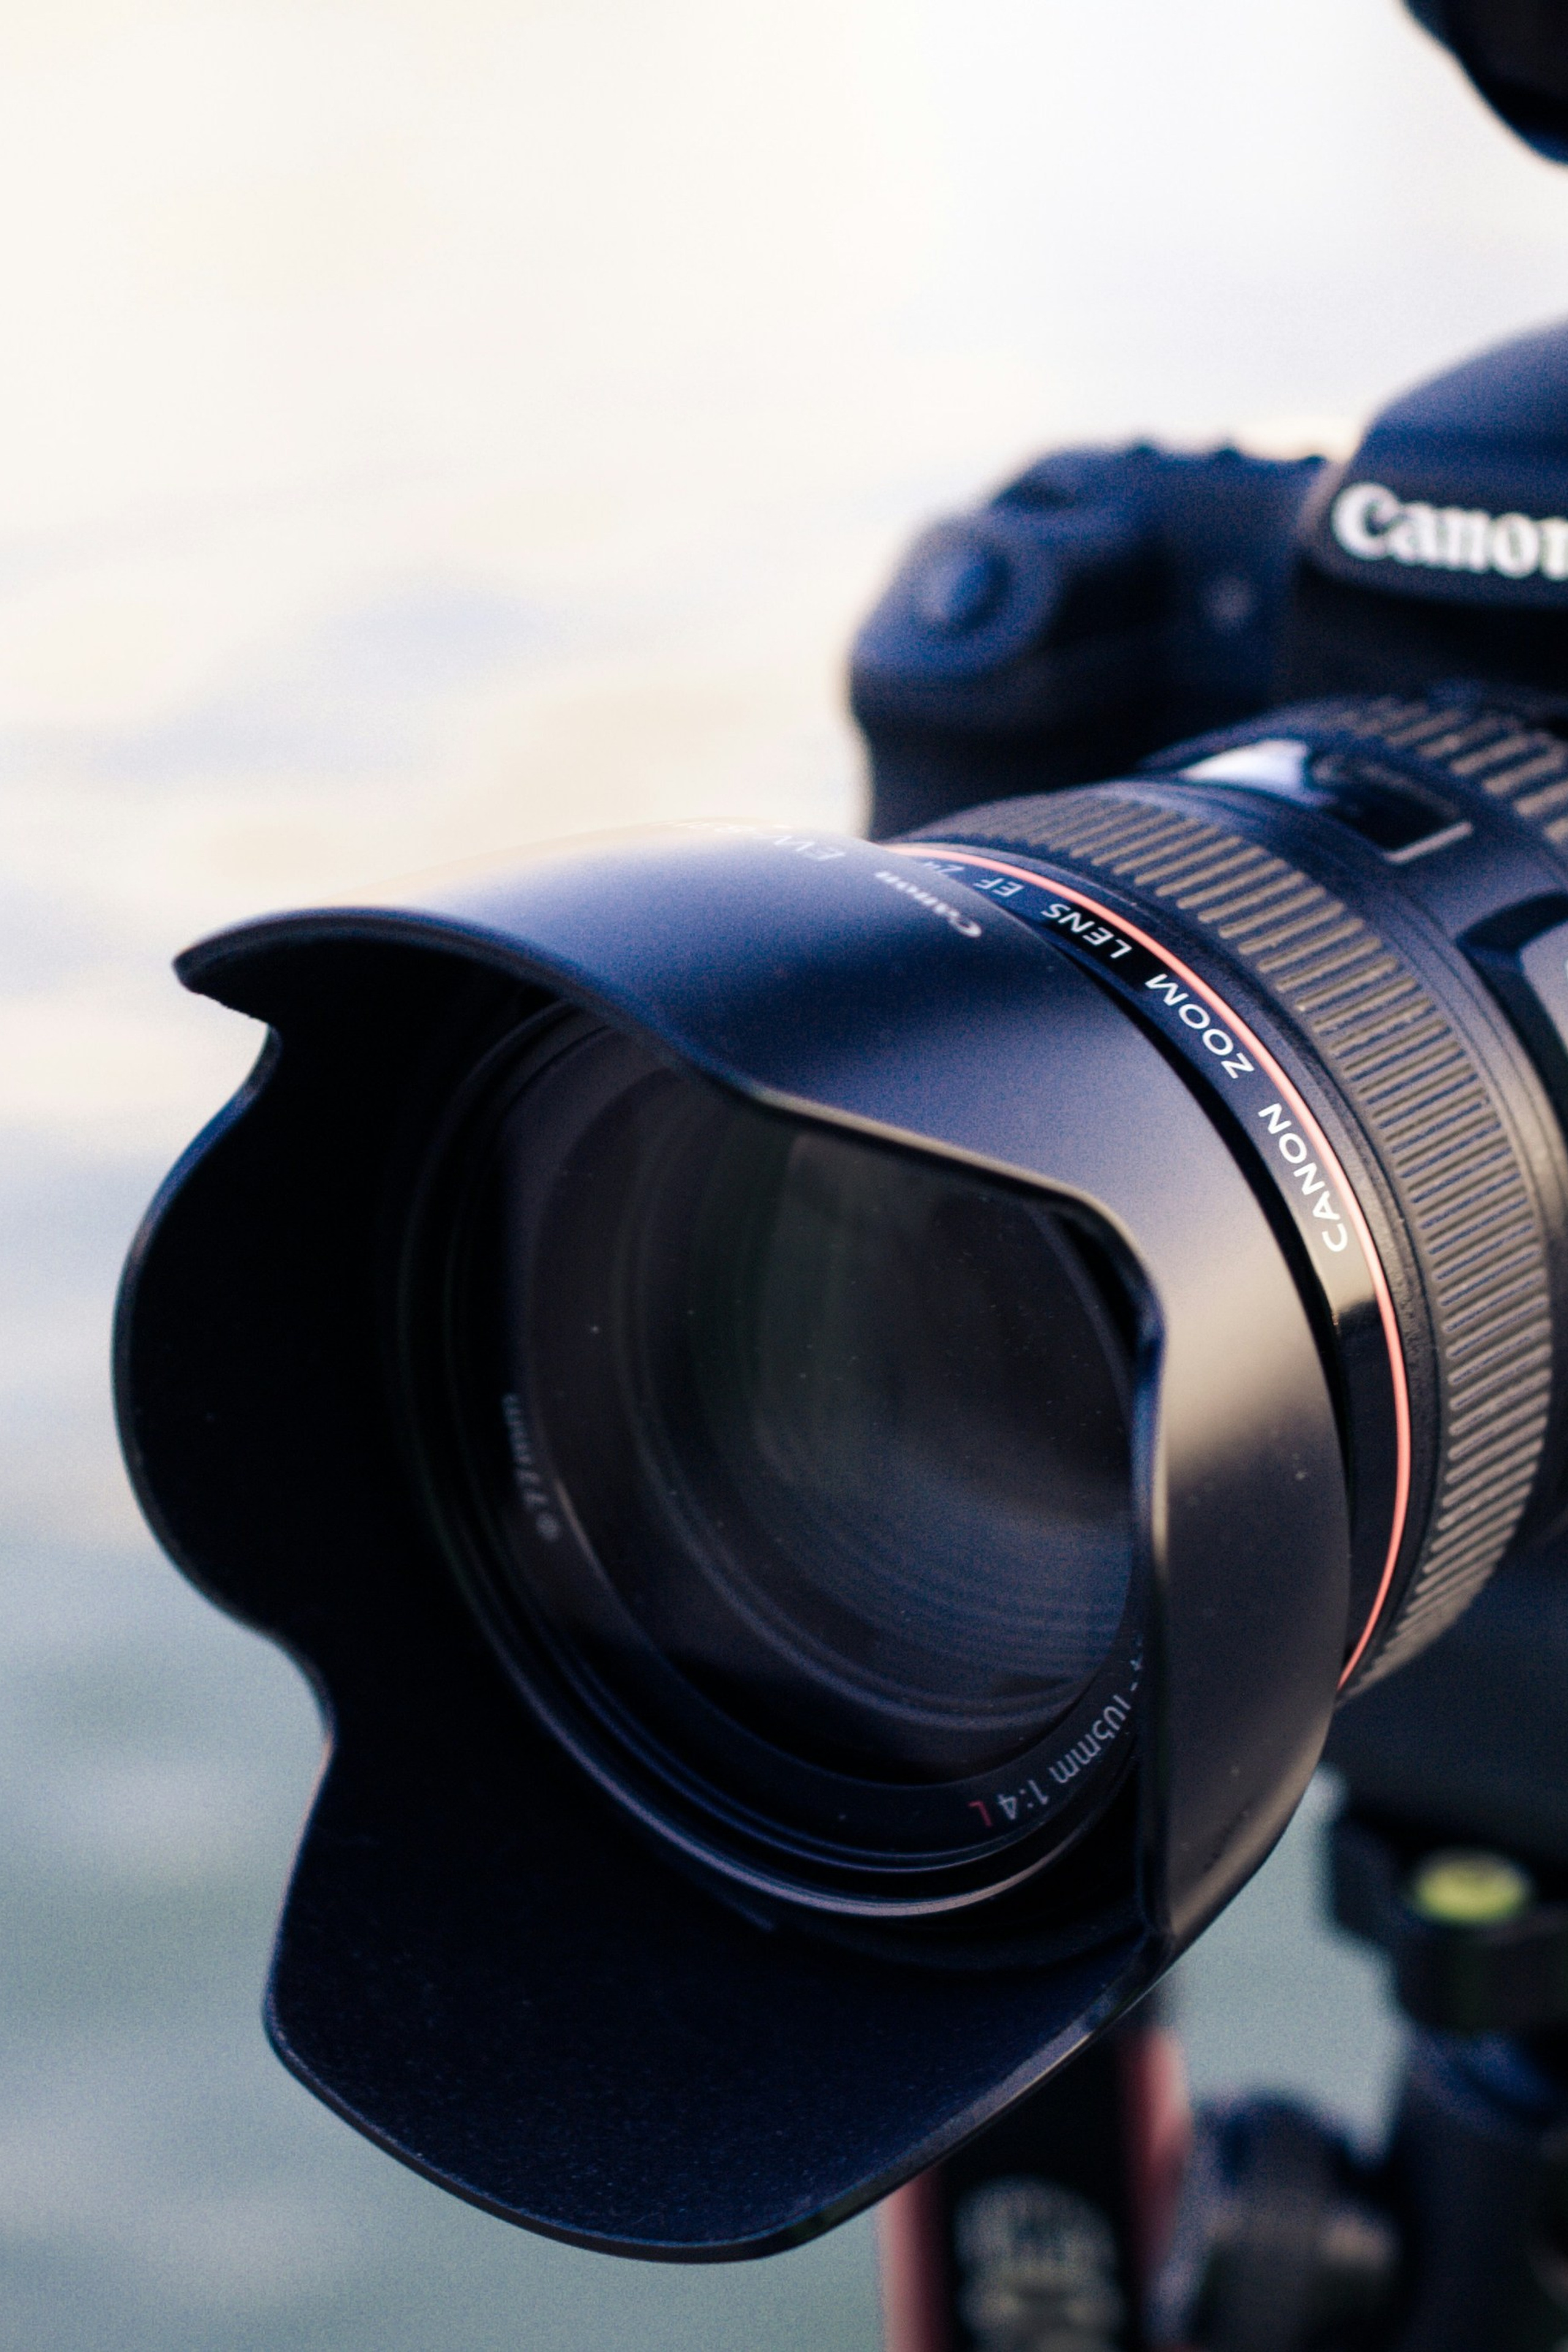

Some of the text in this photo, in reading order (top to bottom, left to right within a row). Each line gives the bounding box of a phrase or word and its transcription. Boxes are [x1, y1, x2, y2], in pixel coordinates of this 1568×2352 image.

[973, 877, 1025, 898] EF
[1041, 902, 1133, 959] LENS
[1145, 973, 1255, 1079] ZOOM
[1258, 1103, 1348, 1252] CANON
[968, 1800, 993, 1828] L
[996, 1779, 1050, 1820] 1:4
